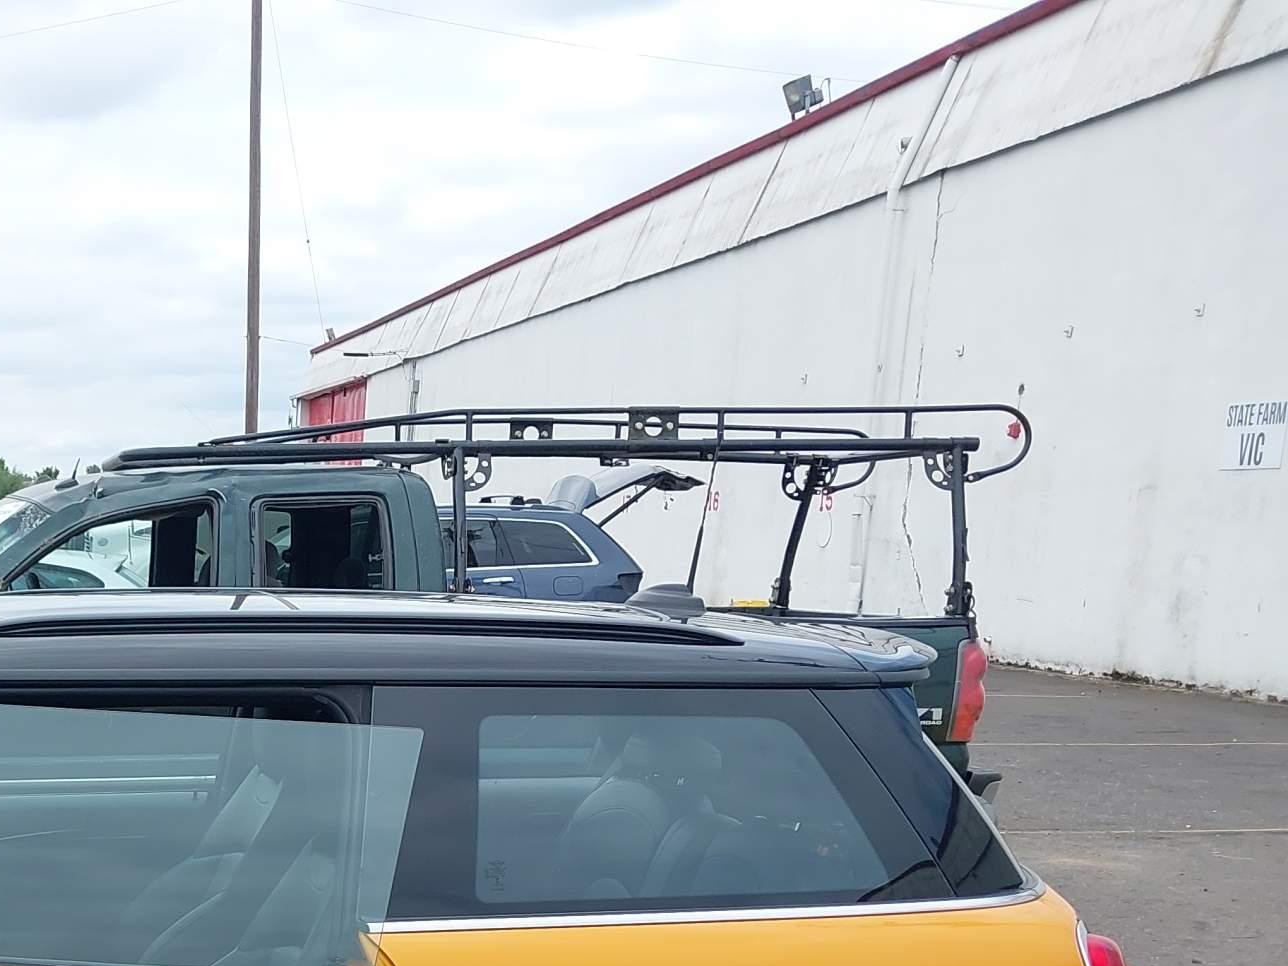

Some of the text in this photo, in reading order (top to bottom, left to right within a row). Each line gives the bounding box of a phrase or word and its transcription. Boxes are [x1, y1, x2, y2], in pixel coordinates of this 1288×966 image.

[1227, 402, 1288, 427] STATE FARM
[1240, 432, 1265, 466] VIC
